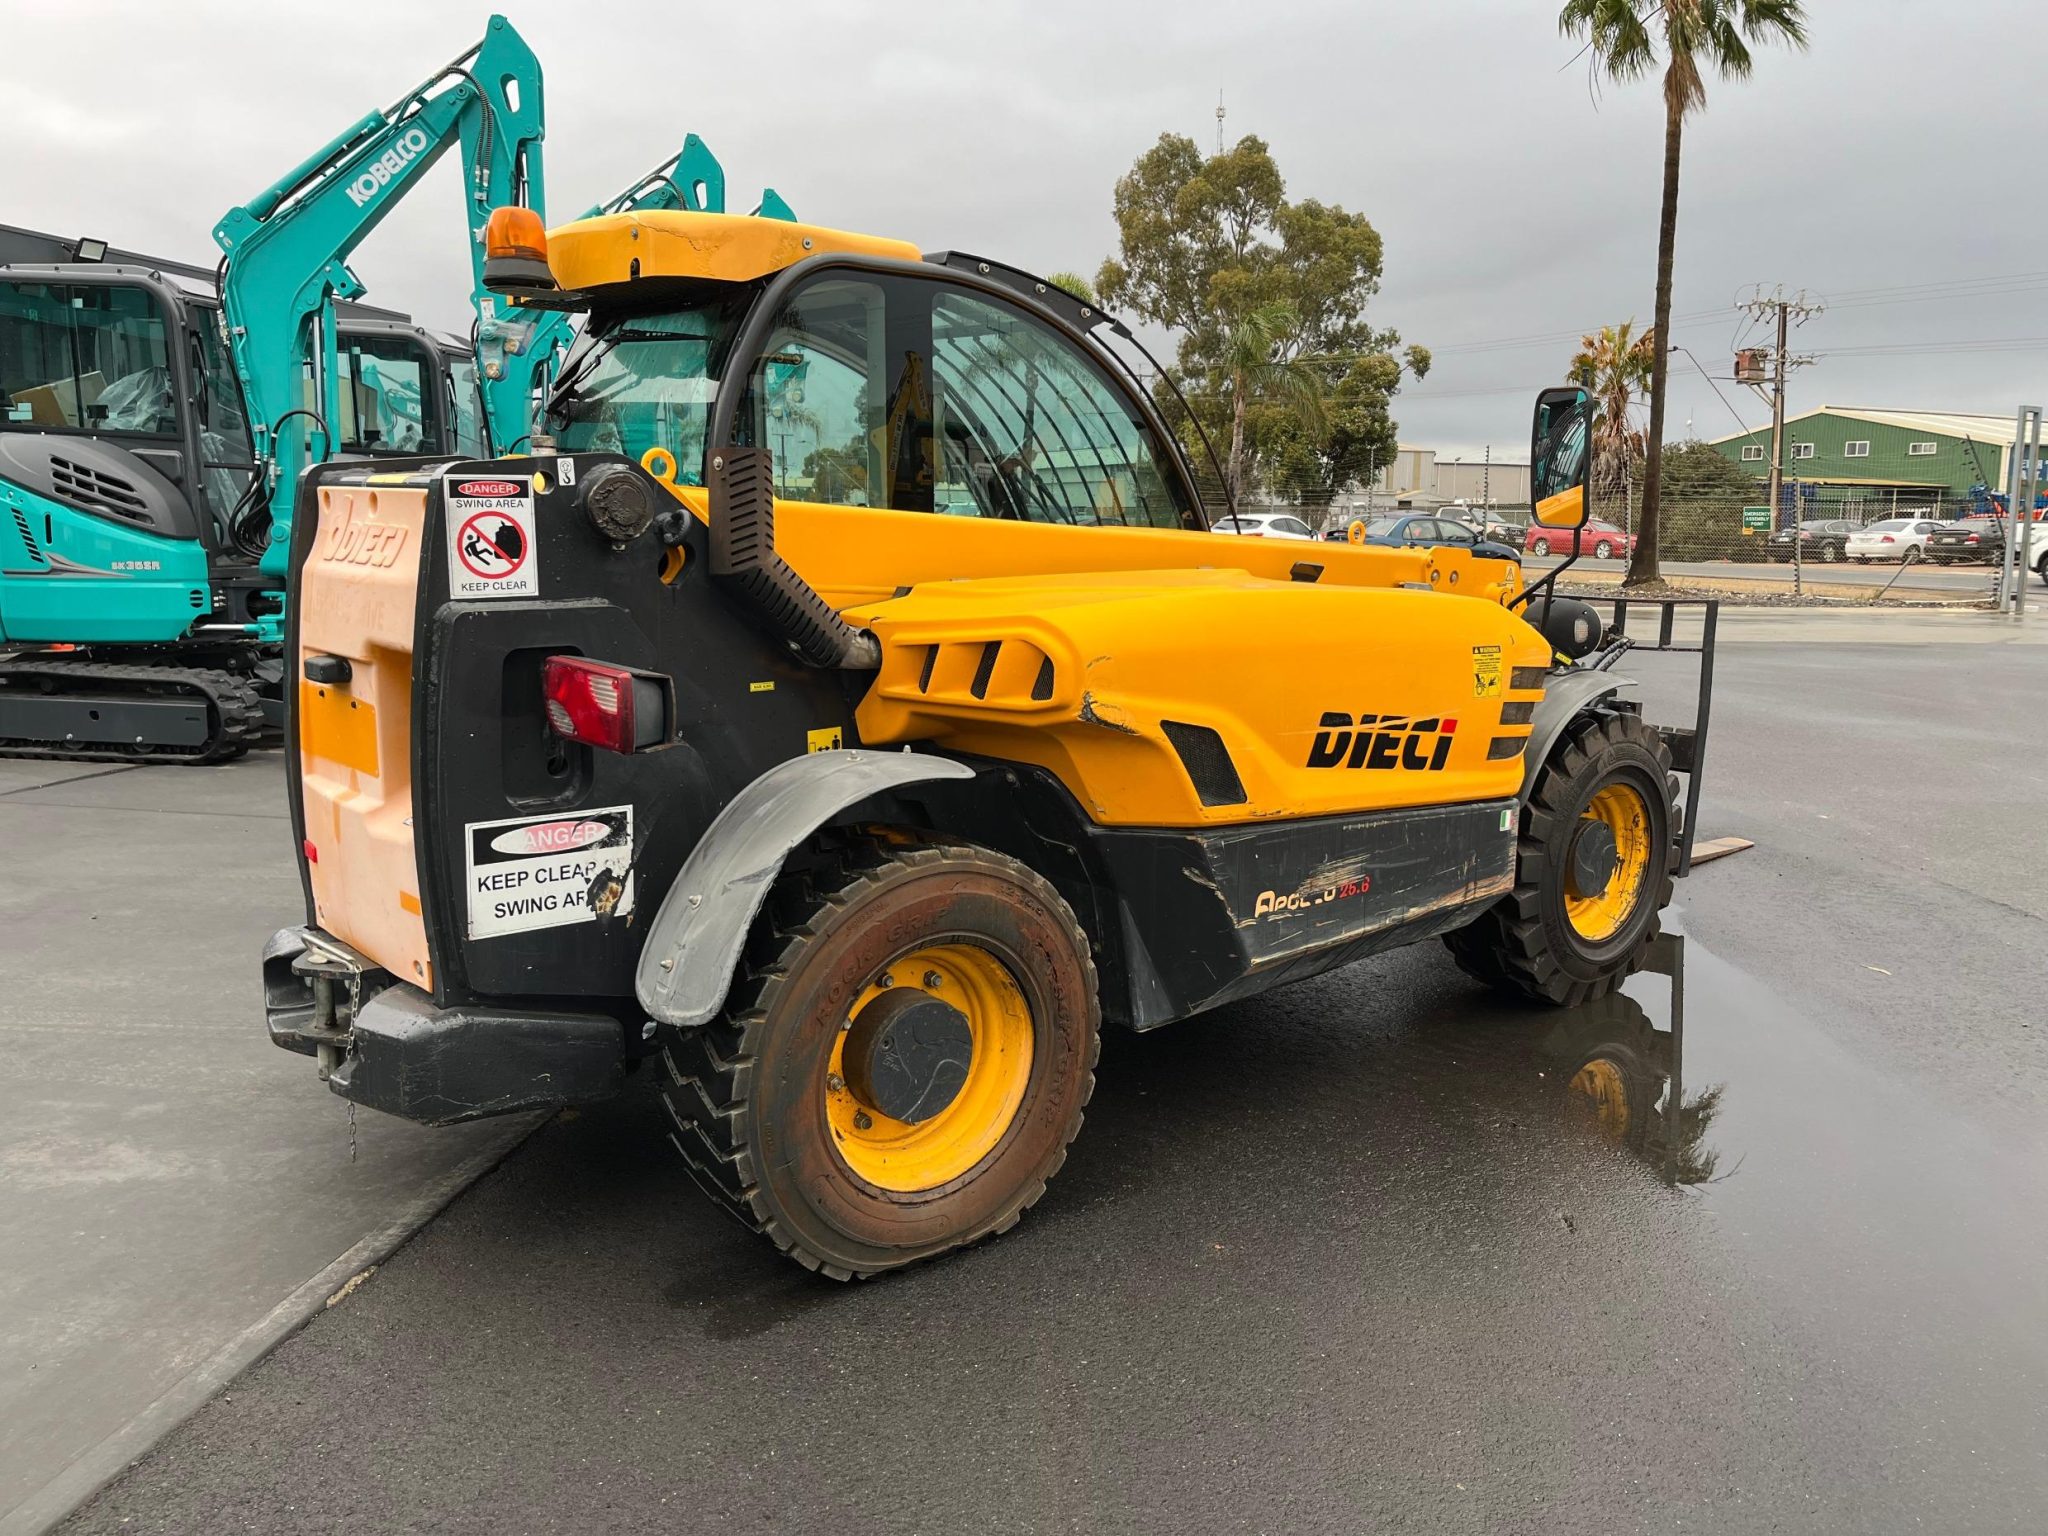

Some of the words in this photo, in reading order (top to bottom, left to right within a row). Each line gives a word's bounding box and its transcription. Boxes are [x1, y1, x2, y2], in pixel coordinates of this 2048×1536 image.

[345, 129, 427, 208] KOBELCO
[465, 484, 514, 493] DANGER
[456, 499, 493, 508] SWING
[495, 499, 524, 508] AREA
[461, 582, 490, 591] KEEP
[492, 581, 527, 590] CLEAR
[1306, 711, 1458, 771] DIECI
[525, 824, 599, 848] ANGER
[478, 871, 529, 893] KEEP
[494, 895, 557, 919] SWING
